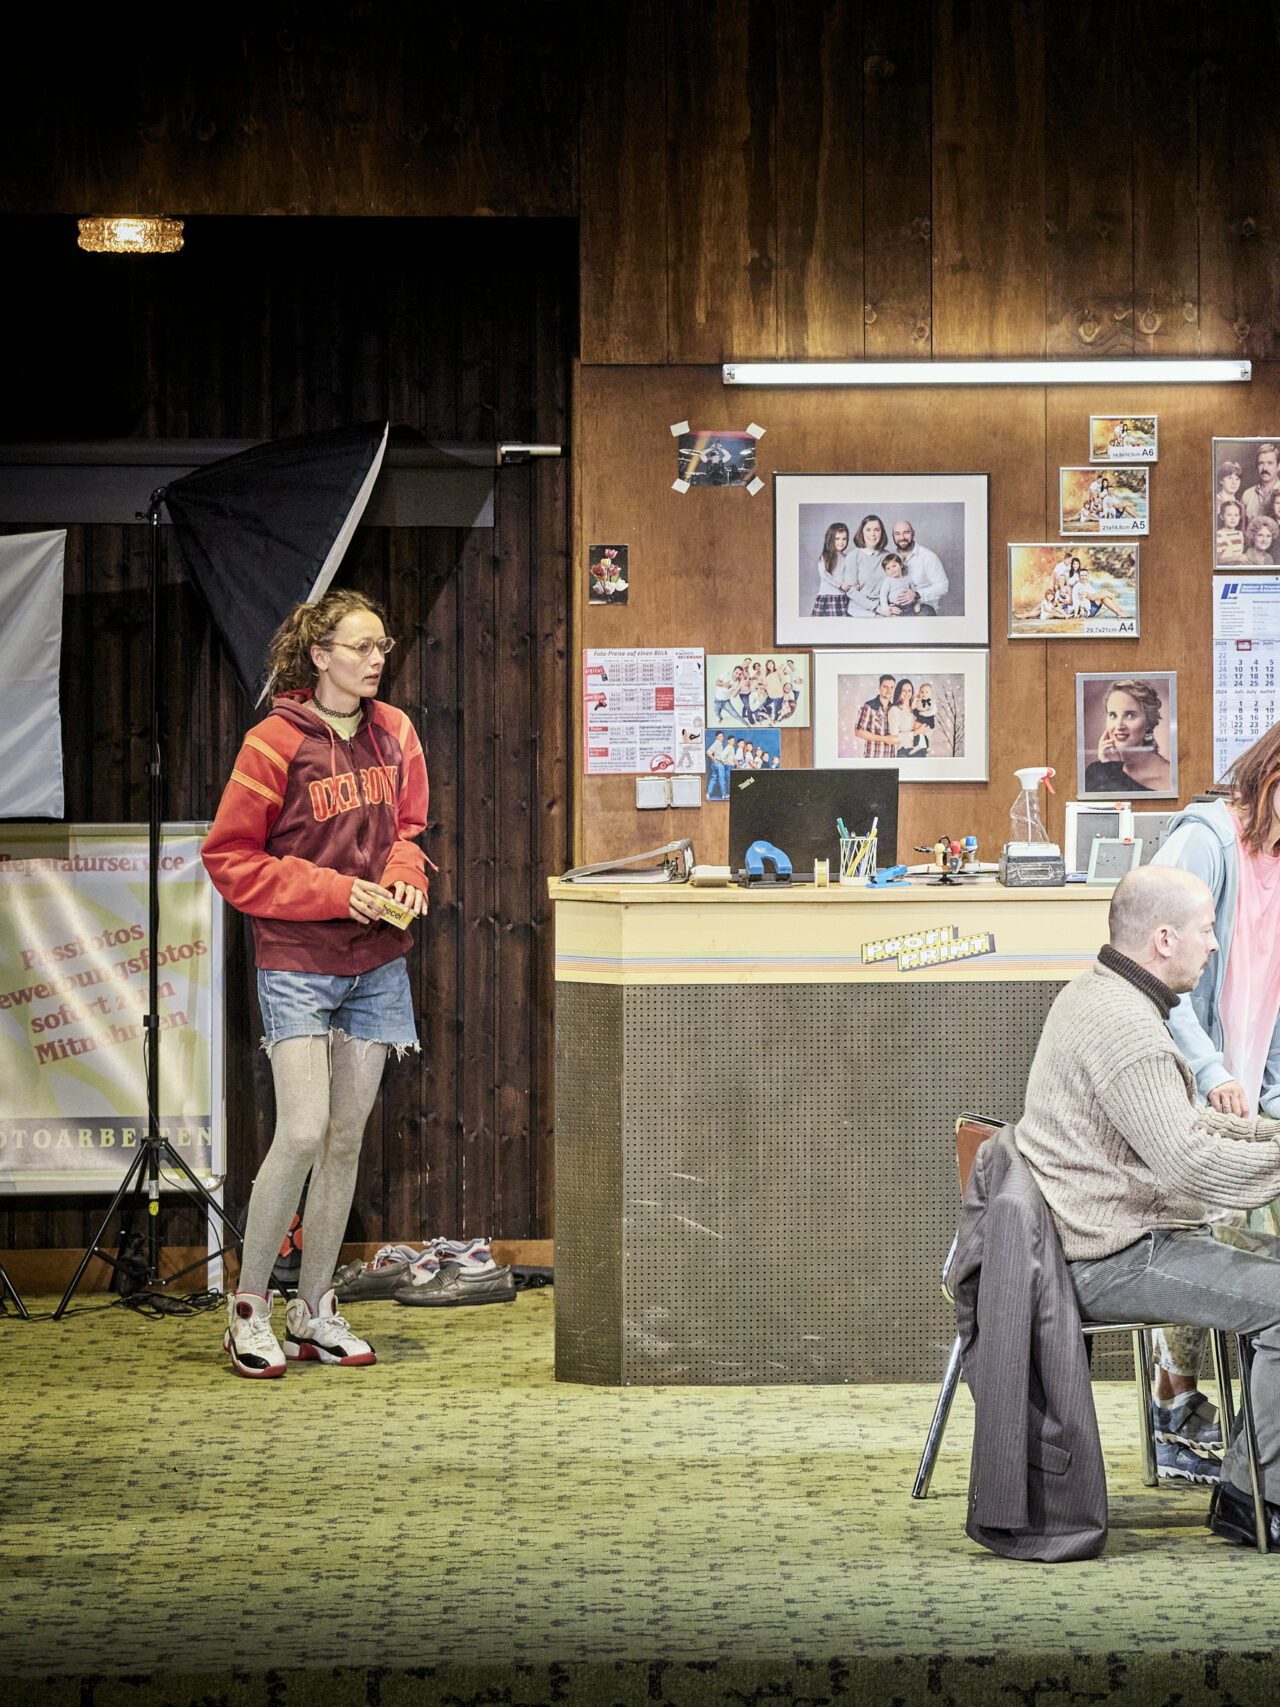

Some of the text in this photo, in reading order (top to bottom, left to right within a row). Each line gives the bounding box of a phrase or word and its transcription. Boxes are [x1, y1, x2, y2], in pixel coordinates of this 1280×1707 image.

[1141, 448, 1154, 457] A6
[1131, 520, 1146, 530] A5
[1119, 622, 1134, 632] A4
[0, 854, 184, 877] Reparaturservce
[20, 924, 144, 971] Passfotos
[866, 930, 949, 958] PROFI
[901, 938, 987, 966] PRINT
[0, 940, 208, 1010] ewerbungsfotos
[31, 996, 111, 1034] sofort
